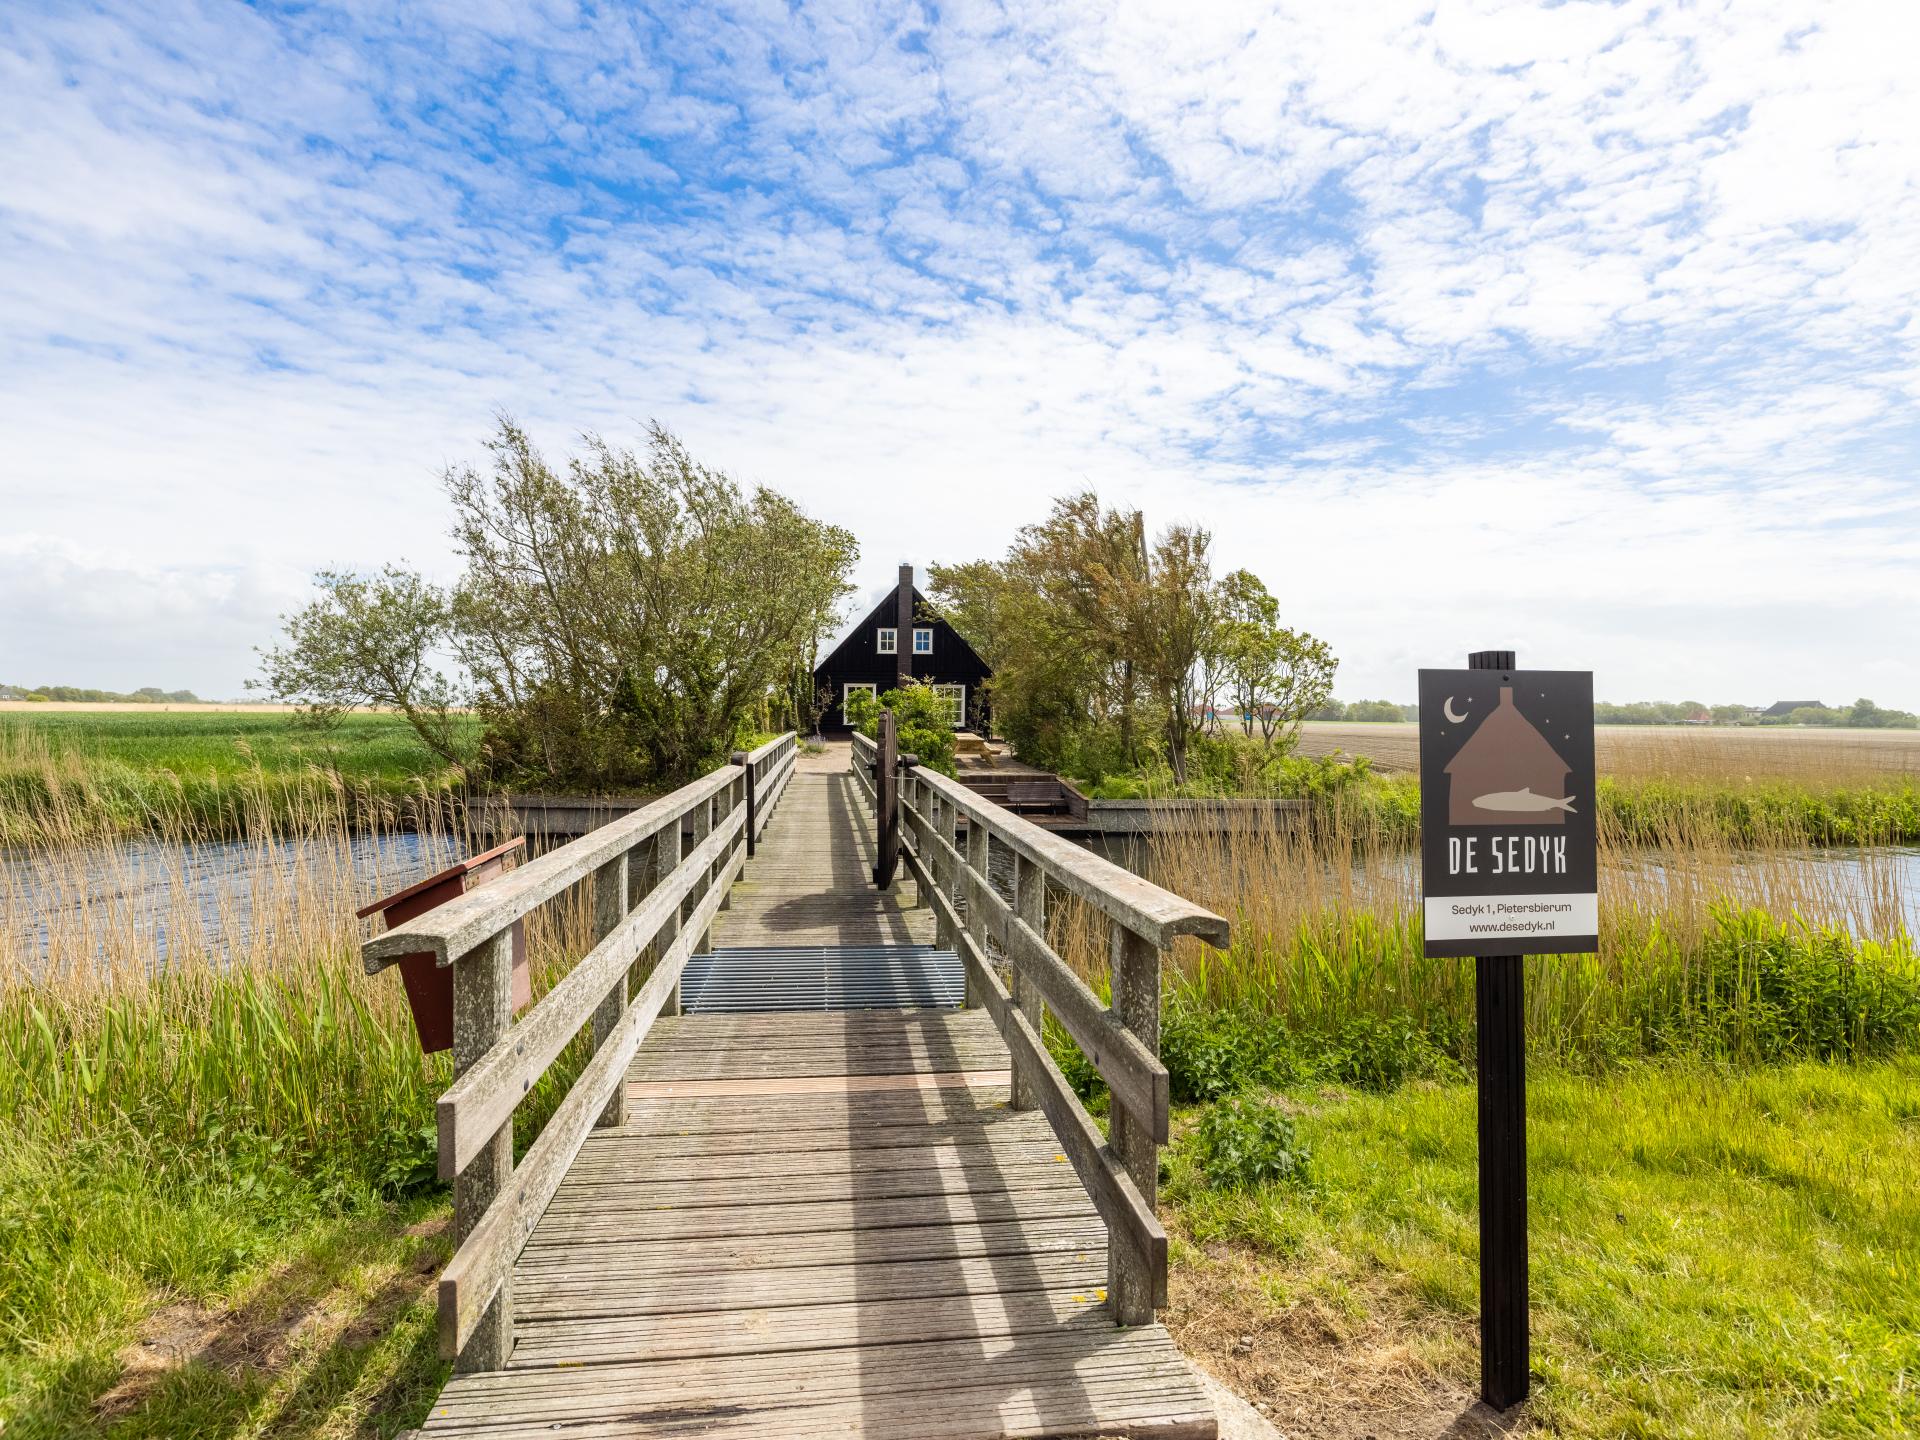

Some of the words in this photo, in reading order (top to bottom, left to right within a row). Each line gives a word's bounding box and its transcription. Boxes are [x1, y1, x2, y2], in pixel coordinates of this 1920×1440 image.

[1449, 837, 1478, 874] DE
[1492, 836, 1566, 874] SEDYK
[1451, 904, 1484, 916] Sedyk
[1497, 902, 1572, 914] Pietersbierum
[1469, 920, 1555, 933] www.desedyk.nl
